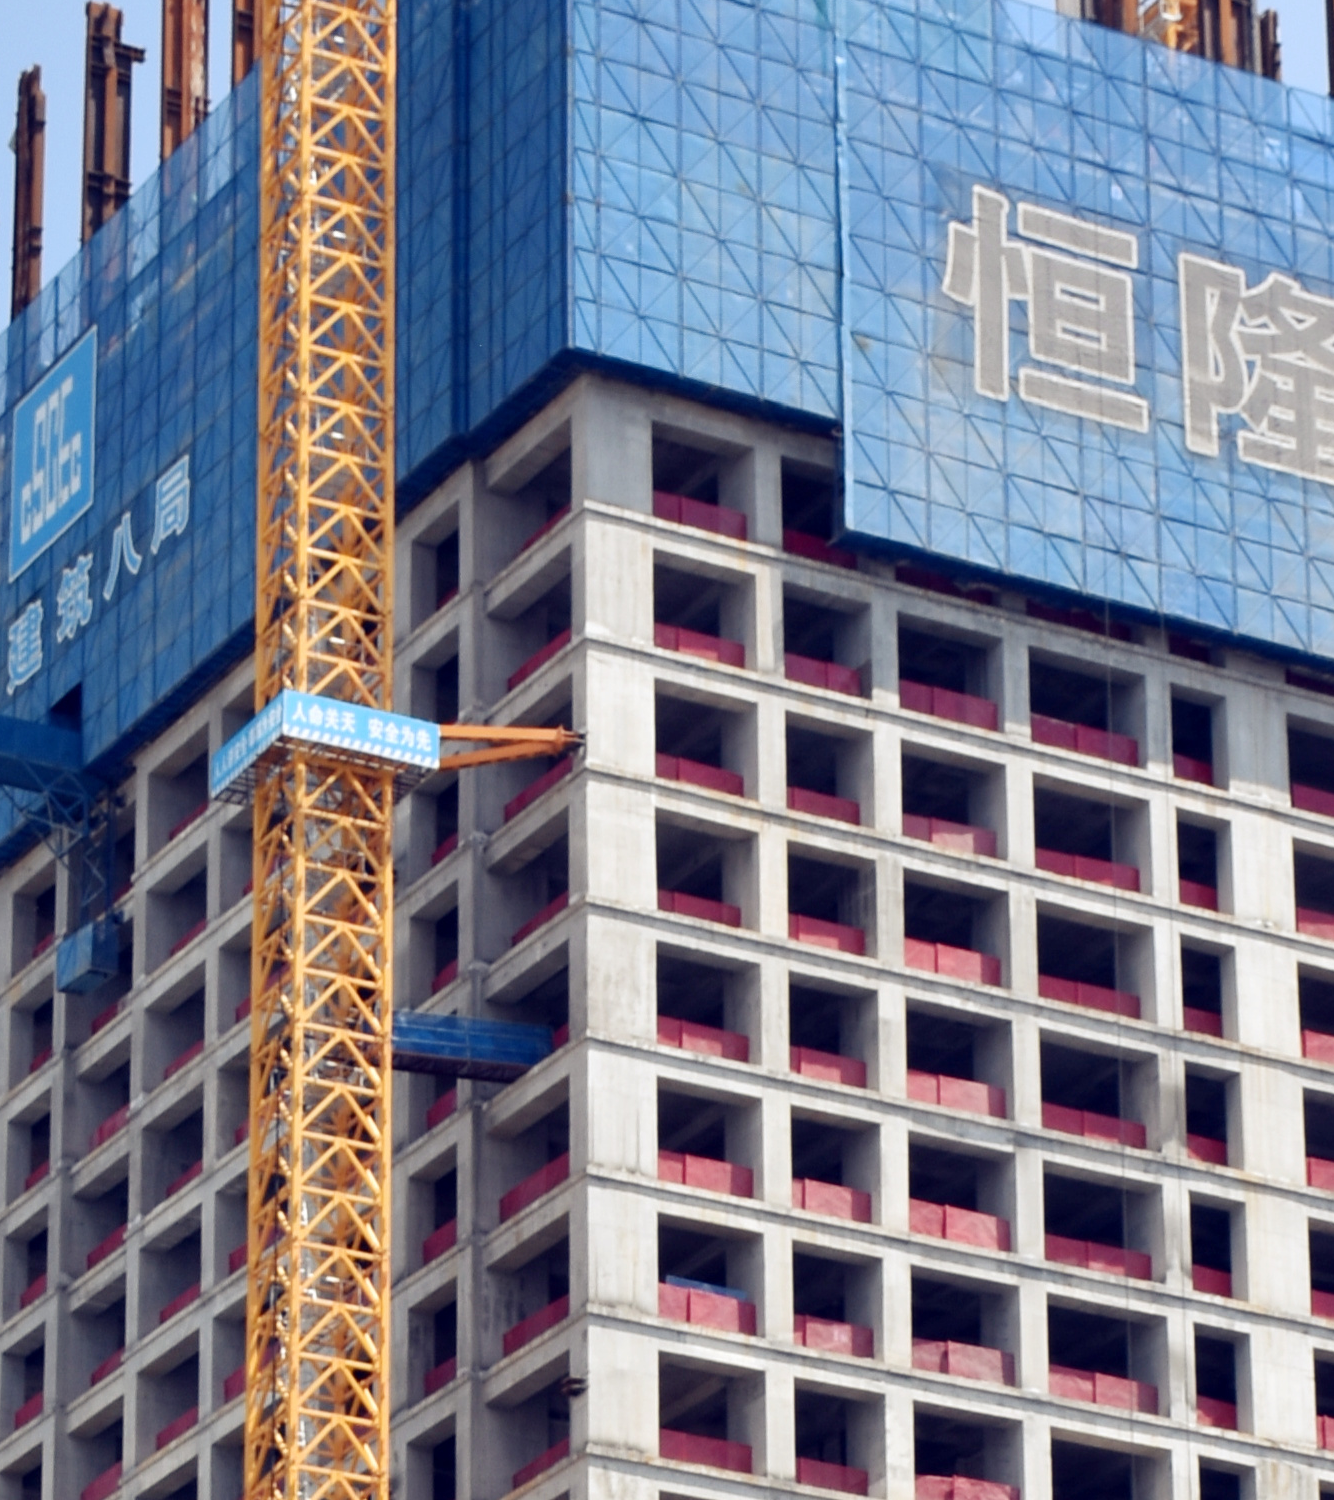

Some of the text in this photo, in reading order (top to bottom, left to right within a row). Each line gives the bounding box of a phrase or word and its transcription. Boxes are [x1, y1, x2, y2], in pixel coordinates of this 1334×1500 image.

[291, 700, 433, 753] 人命关天 安全为先
